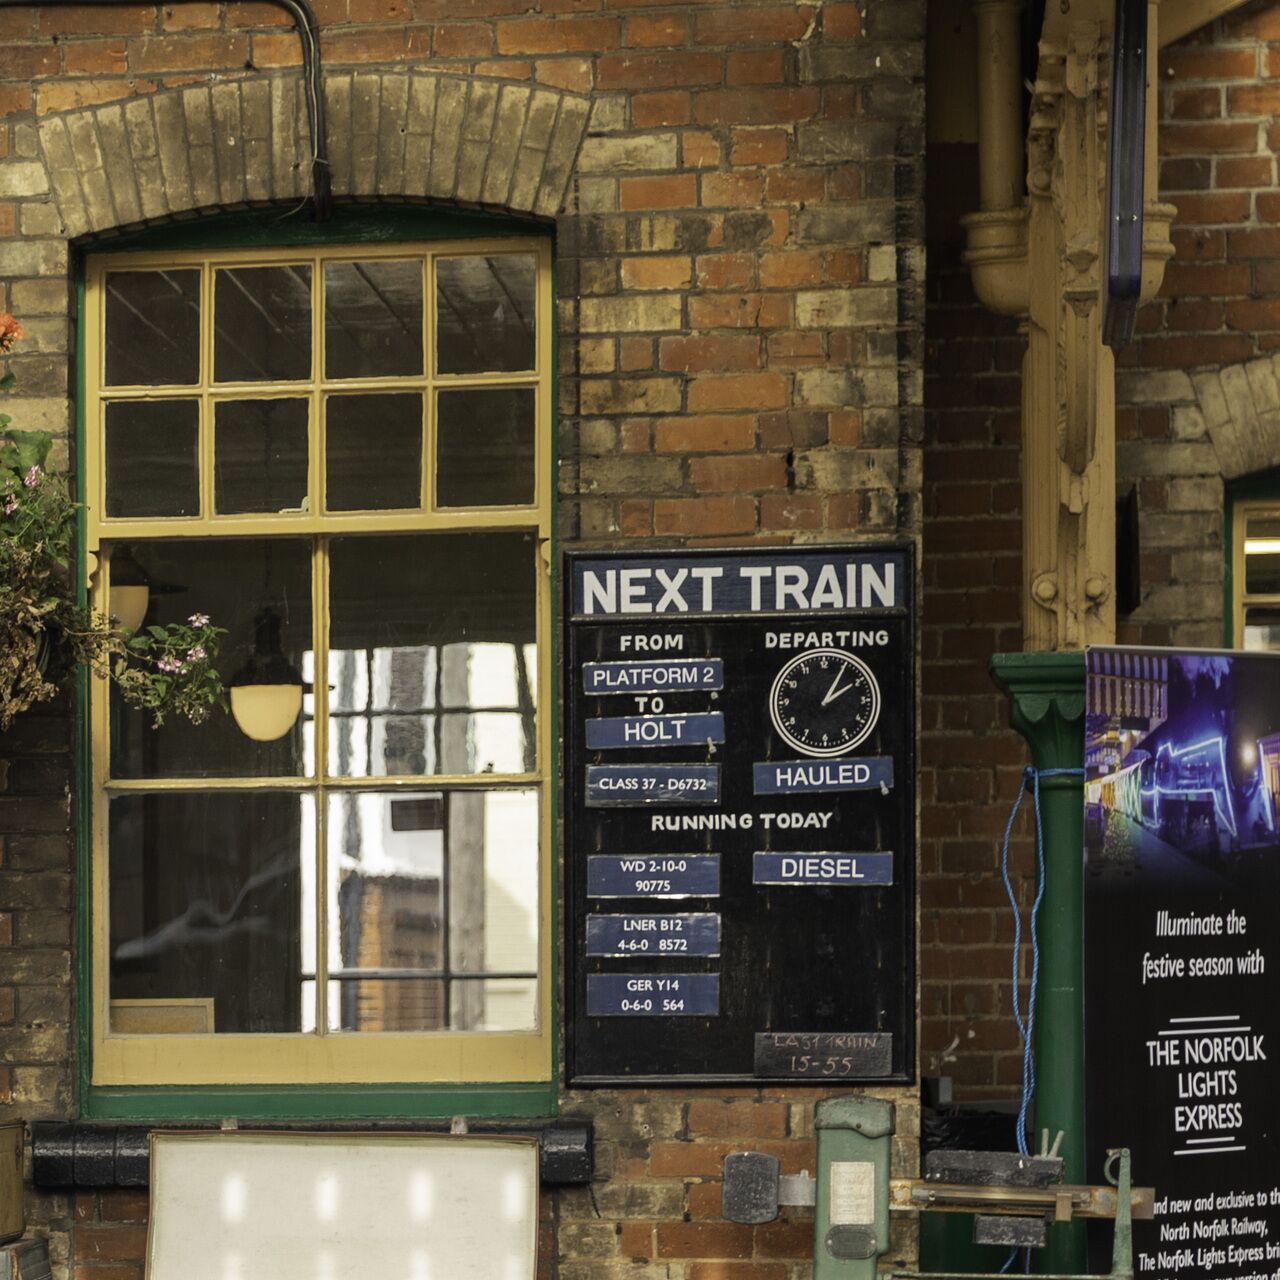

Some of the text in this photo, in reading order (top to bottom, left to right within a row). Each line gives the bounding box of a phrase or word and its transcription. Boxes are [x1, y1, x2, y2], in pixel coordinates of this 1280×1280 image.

[583, 562, 896, 615] NEXT TRAIN
[620, 634, 684, 652] FROM
[765, 630, 889, 649] DEPARTING
[802, 667, 810, 675] 11
[820, 661, 828, 669] 12
[593, 668, 714, 687] PLATFORM 2
[789, 681, 797, 689] 10
[855, 679, 861, 687] 2
[635, 697, 664, 713] TO
[784, 698, 790, 706] 9
[860, 696, 866, 705] 3
[790, 717, 796, 725] 8
[855, 713, 861, 721] 4
[624, 721, 686, 741] HOLT
[804, 729, 810, 737] 7
[822, 733, 829, 741] 6
[842, 728, 847, 736] 5
[776, 765, 870, 787] HAULED
[599, 778, 636, 791] CLASS
[639, 778, 654, 791] 37
[668, 778, 707, 791] D6732
[652, 812, 832, 831] RUNNING TODAY
[620, 861, 687, 872] WD 2-10-0
[782, 859, 865, 878] DIESEL
[635, 880, 671, 892] 90775
[624, 920, 683, 931] LNER B12
[1156, 909, 1247, 936] Illuminate the
[618, 939, 687, 951] 4-6-0 8572
[1143, 948, 1265, 984] festive season with
[627, 980, 680, 991] GER Y14
[622, 1000, 684, 1011] 0-6-0 564
[773, 1034, 877, 1049] LAST TRAIN
[1146, 1035, 1267, 1066] THE NORFOLK
[791, 1056, 853, 1075] 15-55
[1178, 1069, 1237, 1098] LIGHTS
[1174, 1102, 1243, 1132] EXPRESS
[1170, 1200, 1191, 1214] new
[1194, 1192, 1214, 1211] and
[1216, 1191, 1254, 1209] exclusive
[1257, 1191, 1267, 1206] to
[1160, 1216, 1268, 1241] North Norfolk Railway,
[1139, 1253, 1159, 1271] The
[1158, 1249, 1194, 1272] Norfolk
[1197, 1247, 1226, 1270] Lights
[1228, 1244, 1264, 1266] Express
